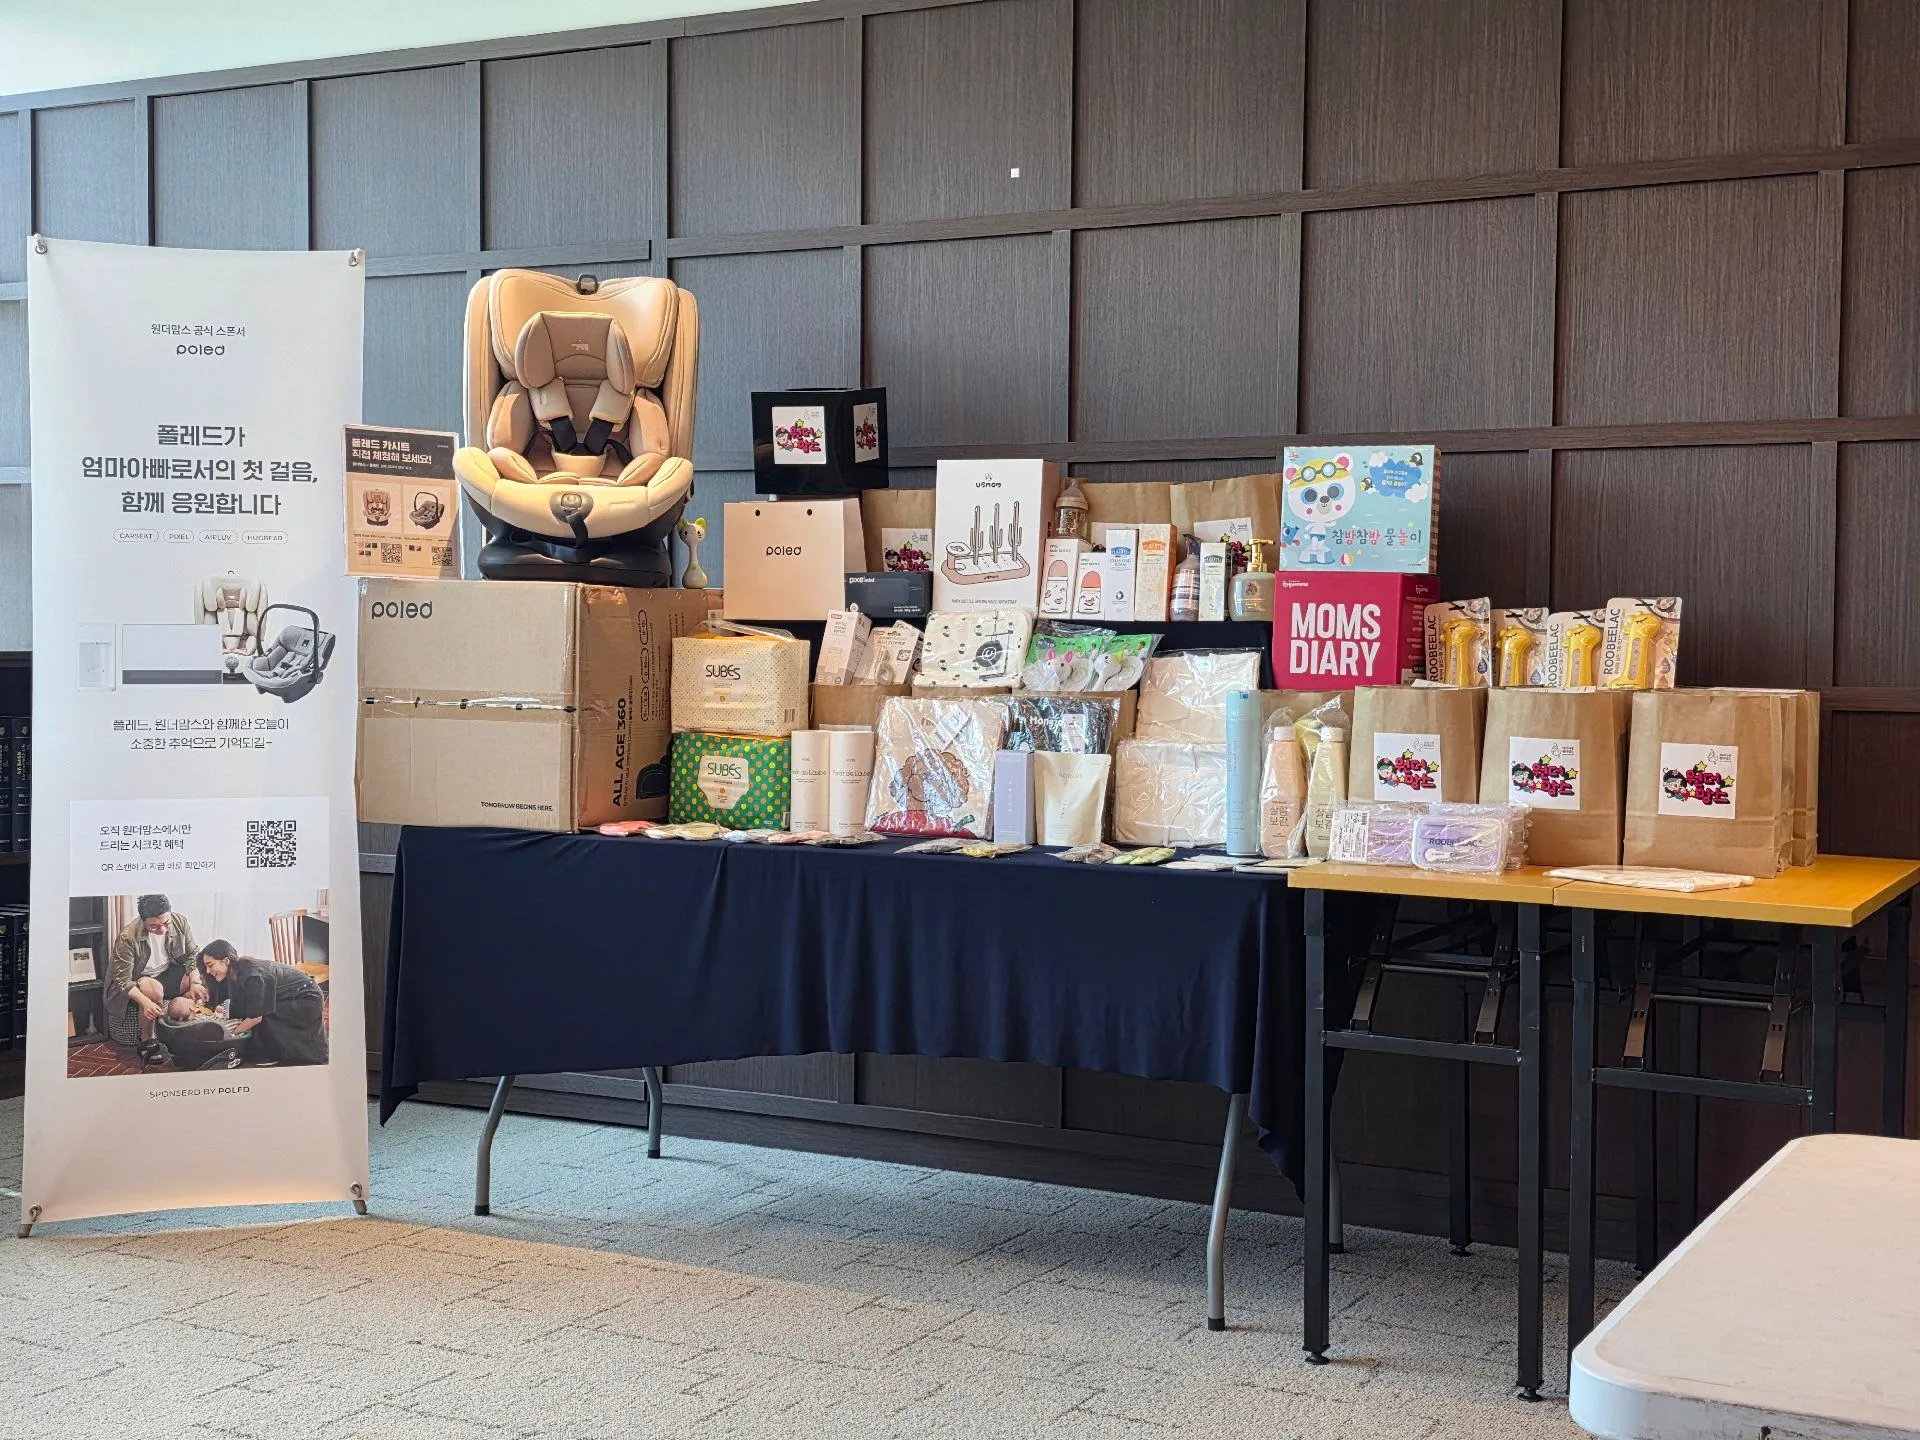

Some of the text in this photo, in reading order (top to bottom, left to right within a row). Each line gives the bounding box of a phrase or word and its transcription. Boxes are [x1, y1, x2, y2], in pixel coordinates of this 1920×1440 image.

[151, 323, 246, 337] 원더맘스 공식 스폰서
[176, 344, 226, 356] poled
[157, 424, 246, 447] 폴레드가
[382, 440, 410, 452] 카시트
[352, 449, 371, 460] 직접
[82, 456, 318, 483] 엄마아빠로서의 첫 걸음,
[121, 491, 282, 515] 함께 응원합니다
[1331, 528, 1422, 546] 참방참방 물놀이
[765, 545, 802, 557] poled
[371, 600, 433, 619] poled
[1291, 602, 1381, 640] MOMS
[1427, 615, 1439, 682] ROOBEELAC
[1603, 608, 1621, 675] ROOBEELAC
[1290, 640, 1381, 677] DIARY
[1548, 623, 1560, 688] ROOBEELAC
[705, 665, 741, 680] SUBES
[155, 719, 214, 731] 원더맘스와
[217, 718, 252, 730] 함께한
[254, 718, 289, 730] 오늘이
[131, 738, 167, 750] 소중한
[169, 737, 217, 749] 추억으로
[612, 698, 626, 807] ALL AGE 360
[707, 763, 742, 780] SUBES
[480, 801, 516, 809] TOMORROW
[515, 803, 537, 811] BEGINS
[100, 824, 192, 836] 오직 원더맘스에서만
[100, 839, 184, 851] 드리는 시크릿 혜택
[101, 863, 114, 872] QR
[203, 1087, 216, 1096] BY
[218, 1086, 250, 1095] POLED
